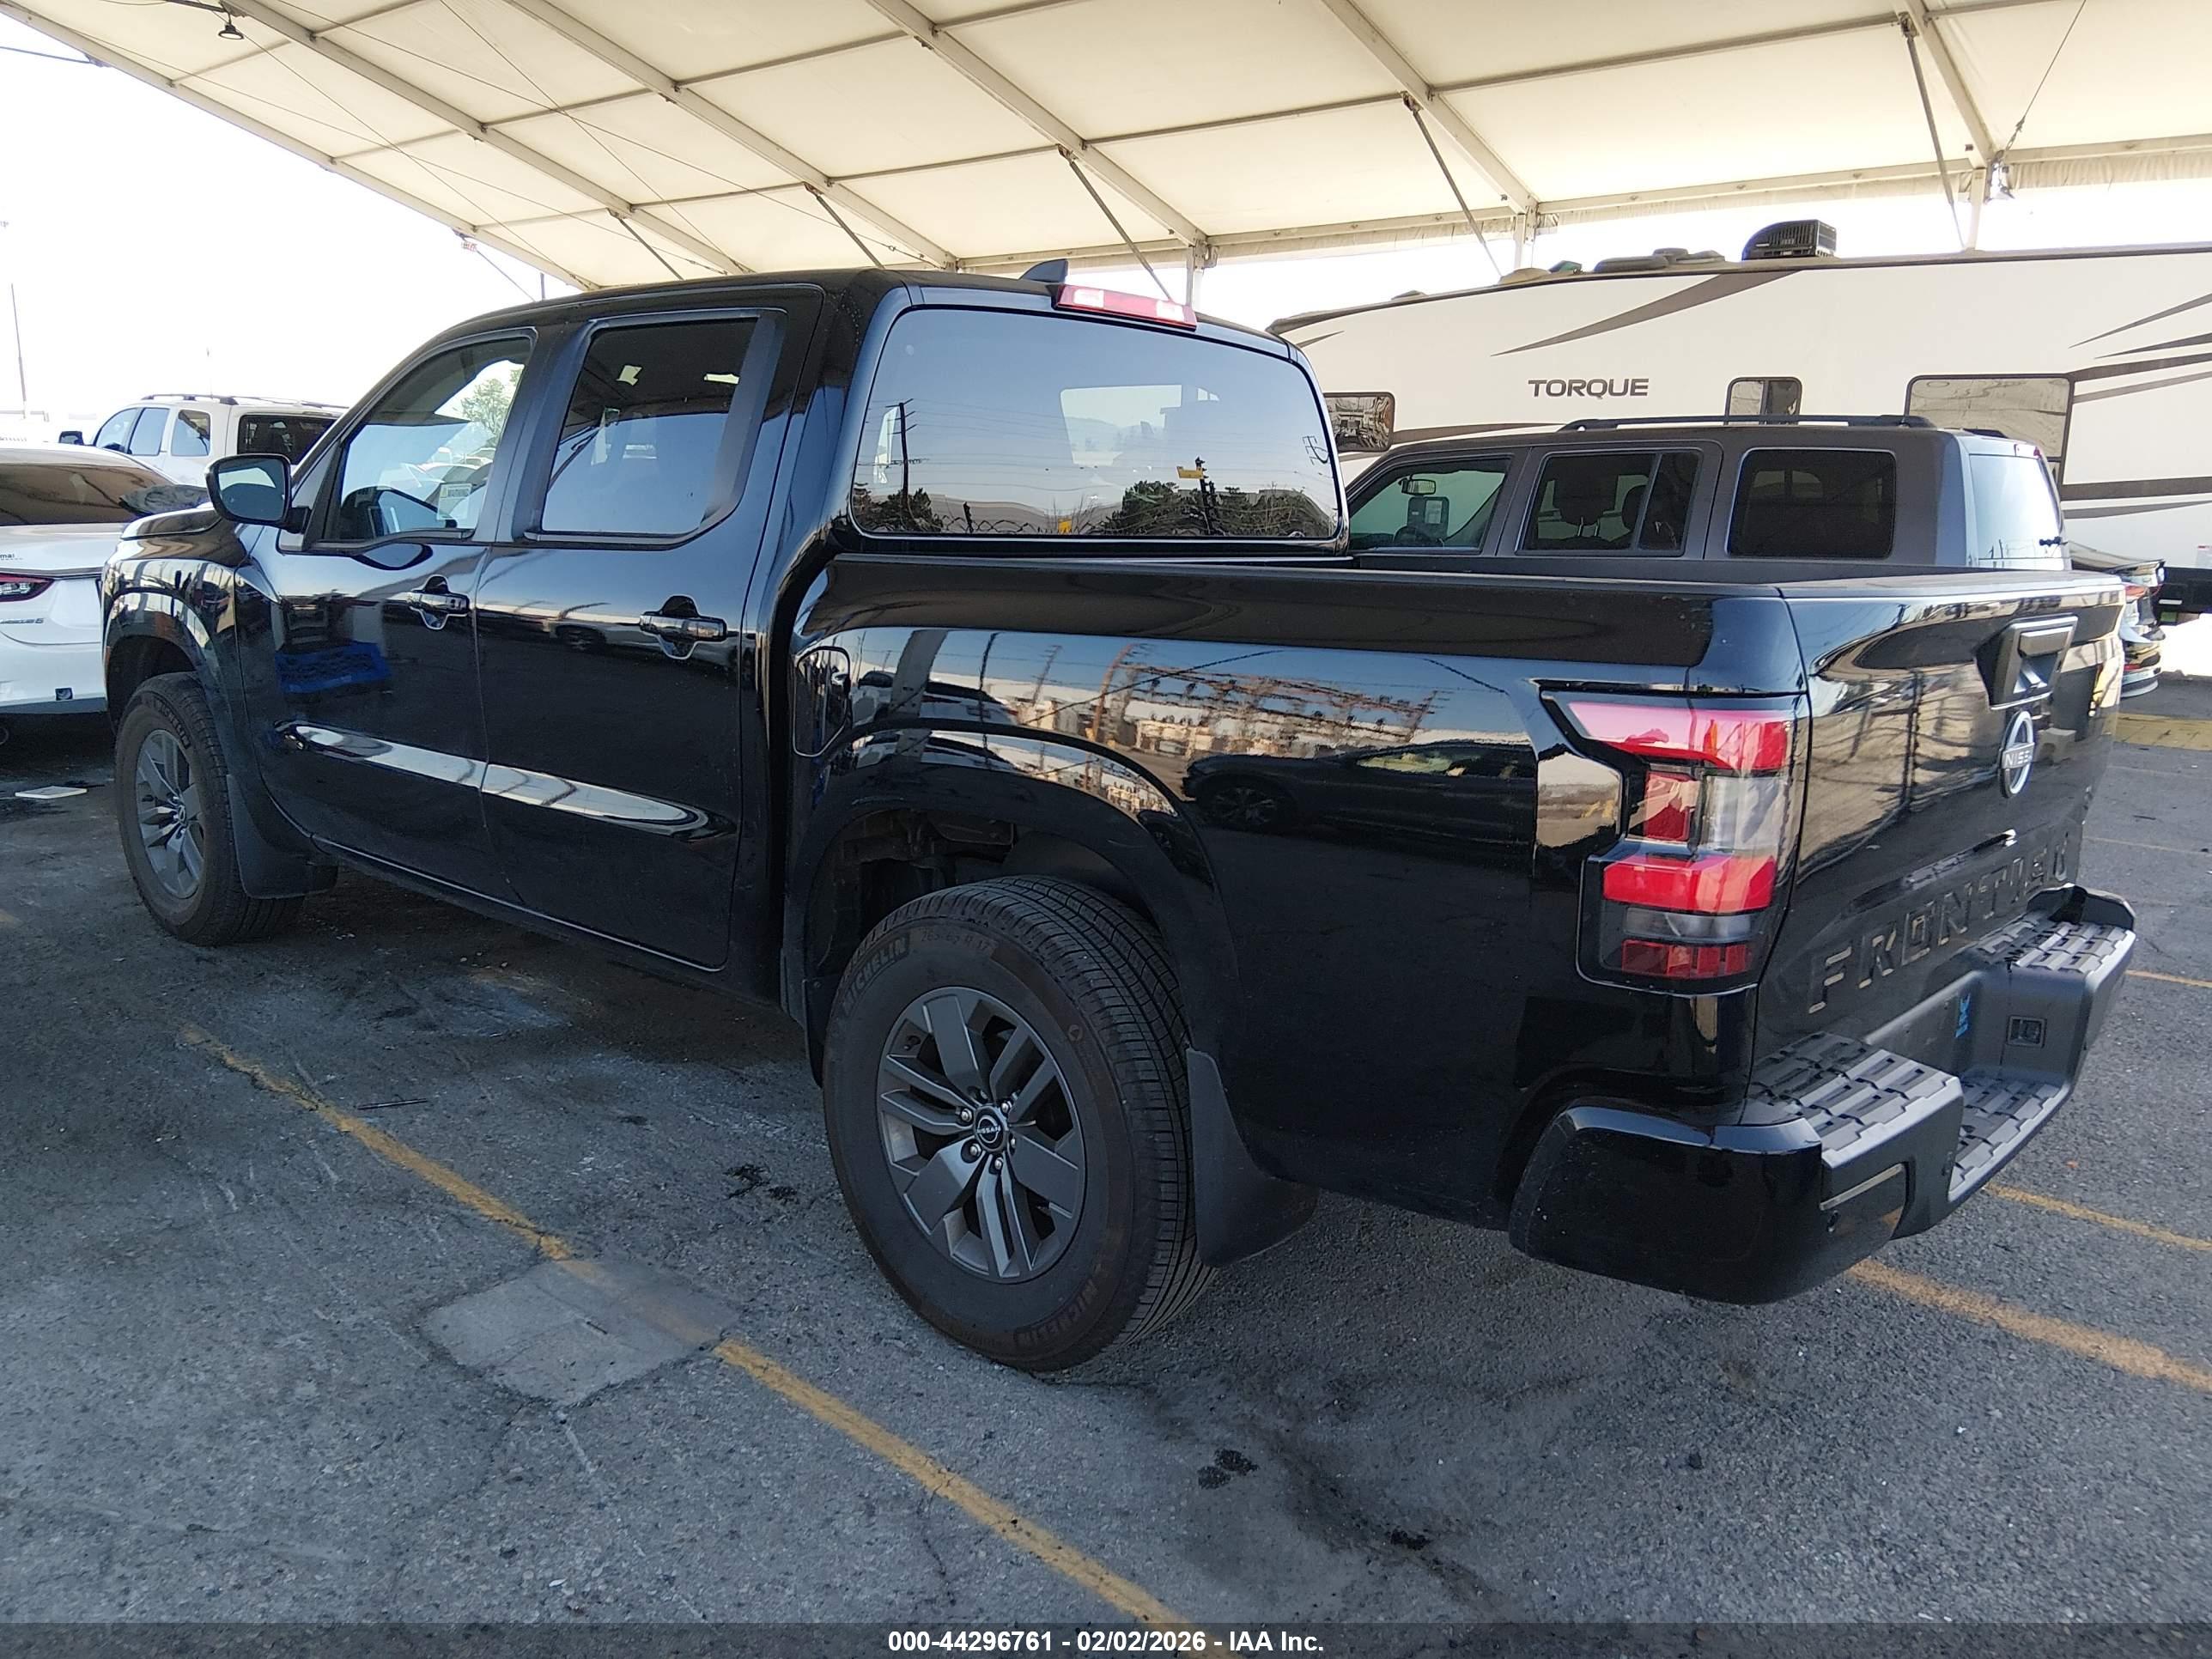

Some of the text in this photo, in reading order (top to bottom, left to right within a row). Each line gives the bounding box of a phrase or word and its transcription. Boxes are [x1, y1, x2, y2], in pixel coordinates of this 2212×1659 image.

[1528, 378, 1650, 399] TORQUE
[2004, 750, 2032, 768] NISS
[1808, 831, 2069, 1014] FRONTIER
[842, 933, 907, 1019] MICHELIN
